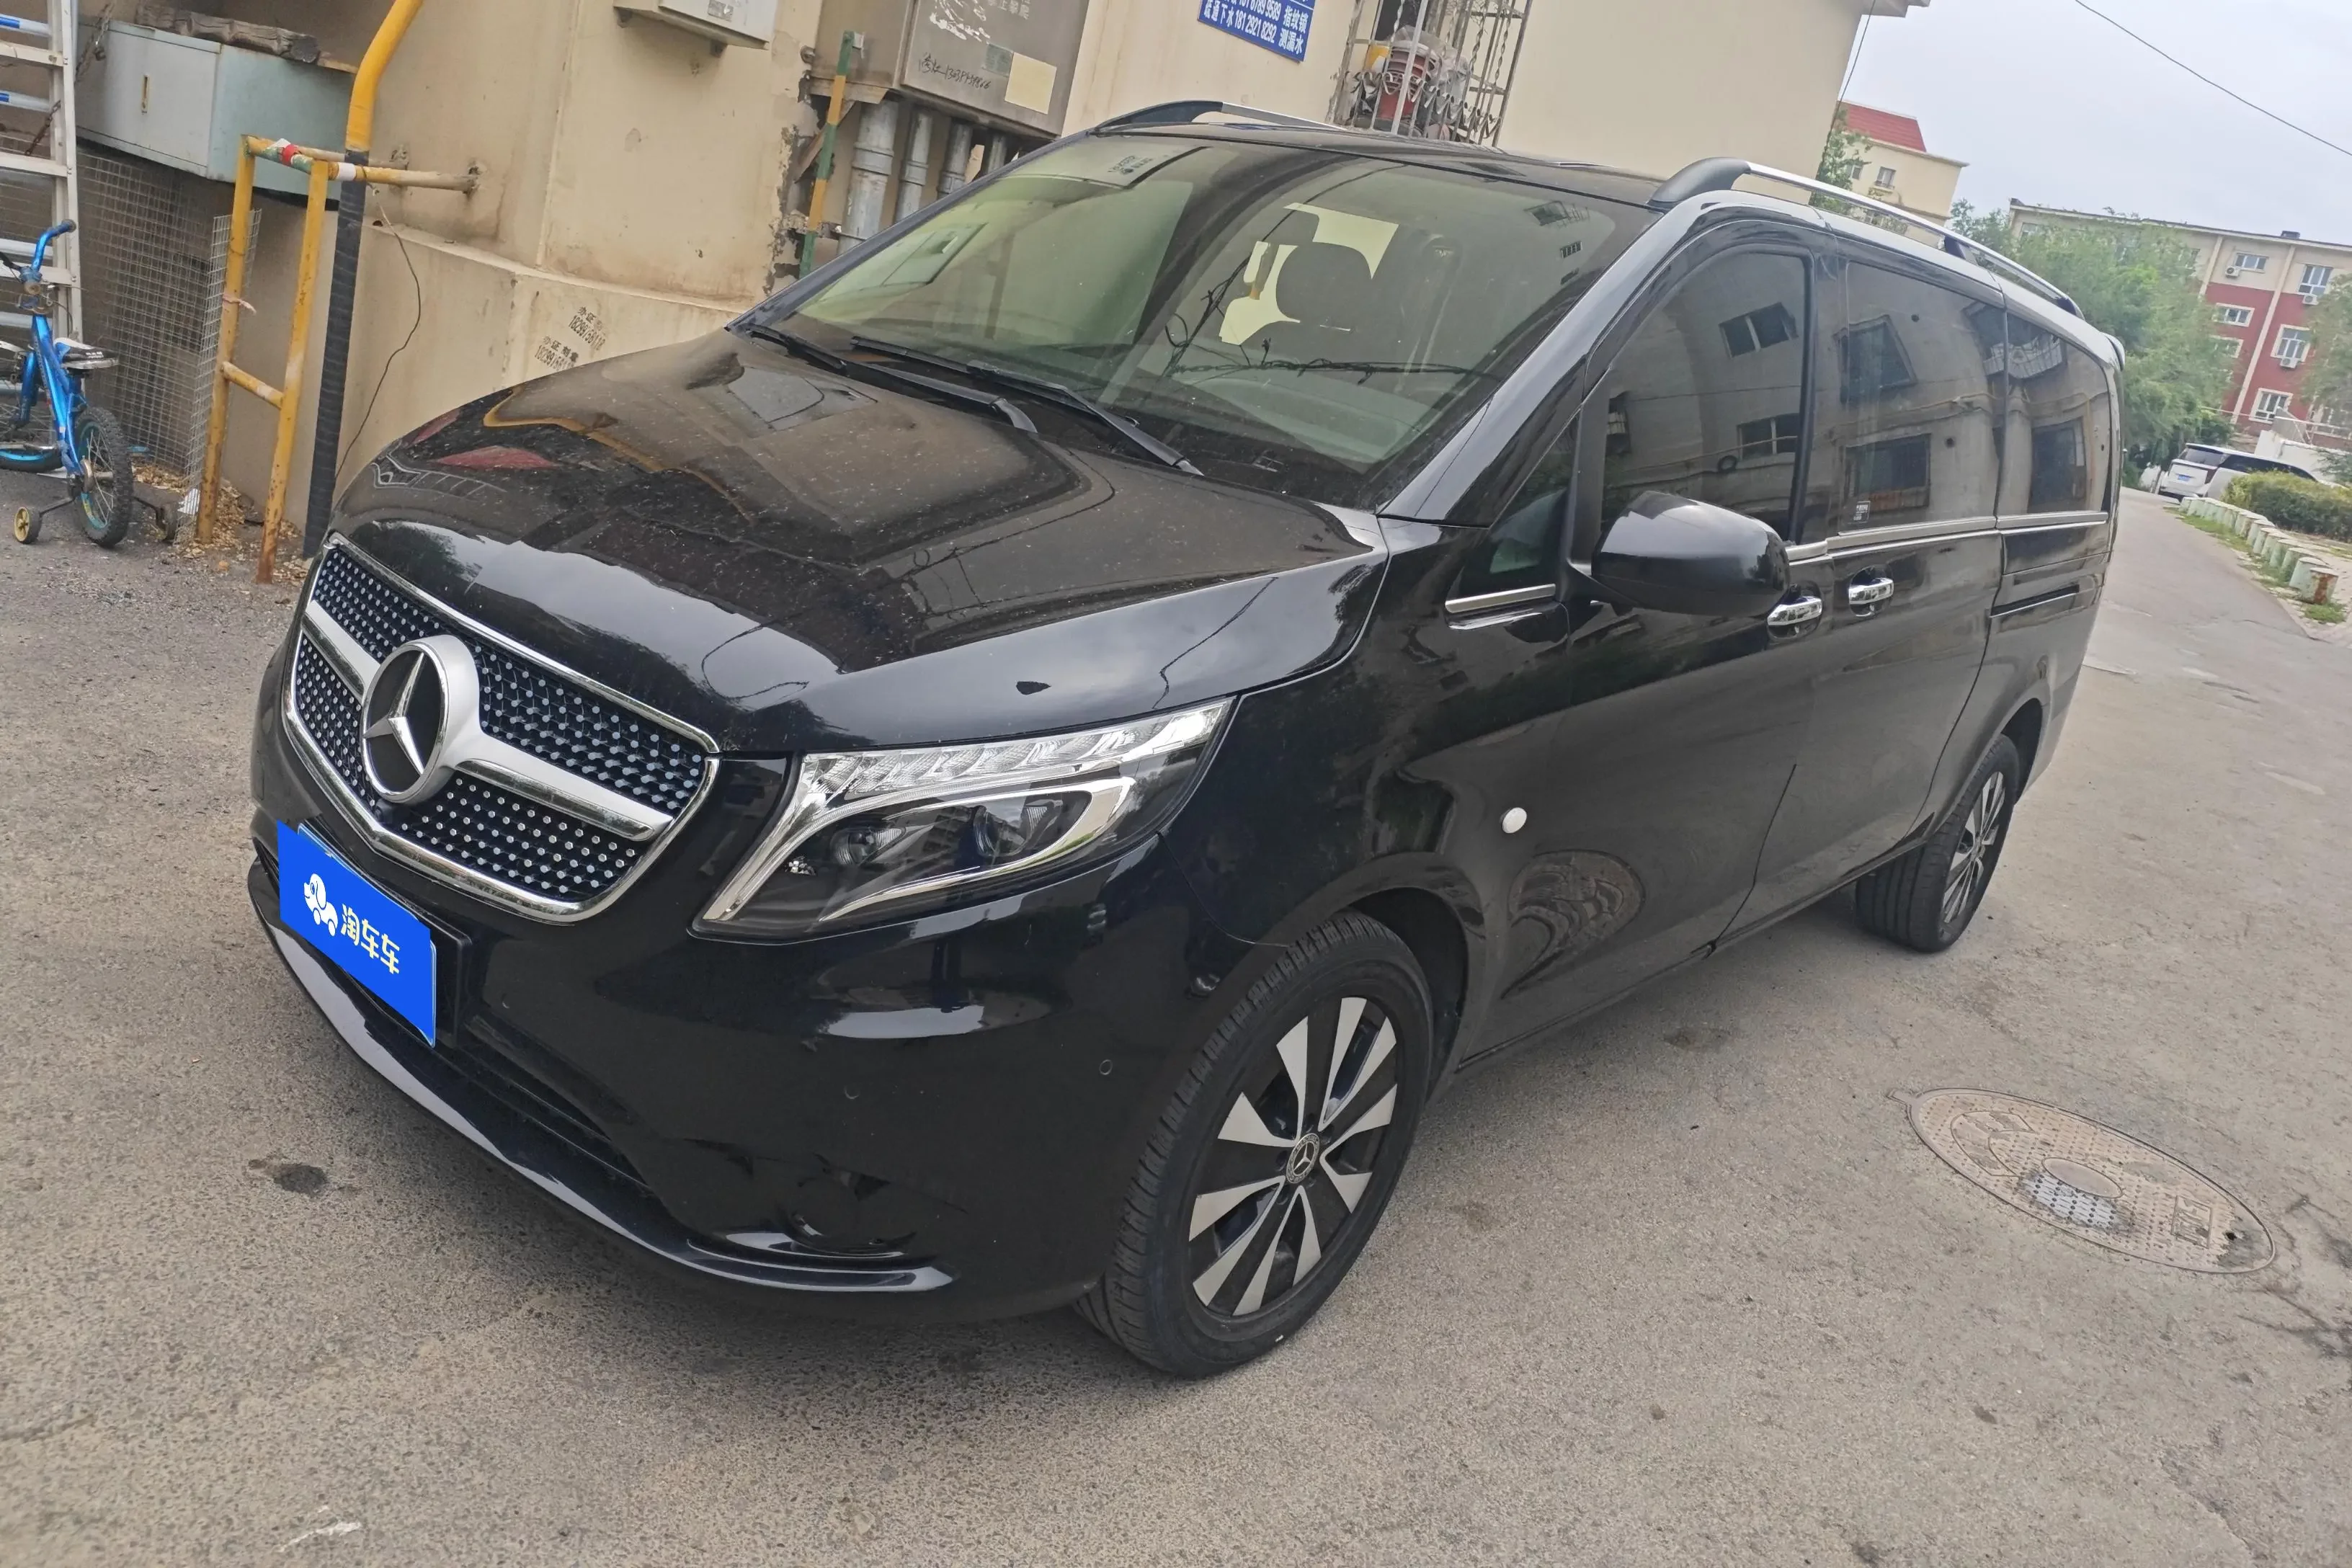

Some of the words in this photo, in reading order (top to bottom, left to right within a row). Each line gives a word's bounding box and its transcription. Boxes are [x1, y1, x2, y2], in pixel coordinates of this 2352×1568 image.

[1234, 9, 1247, 31] 181
[1278, 27, 1304, 55] 测漏水
[1283, 5, 1309, 34] 指纹锁
